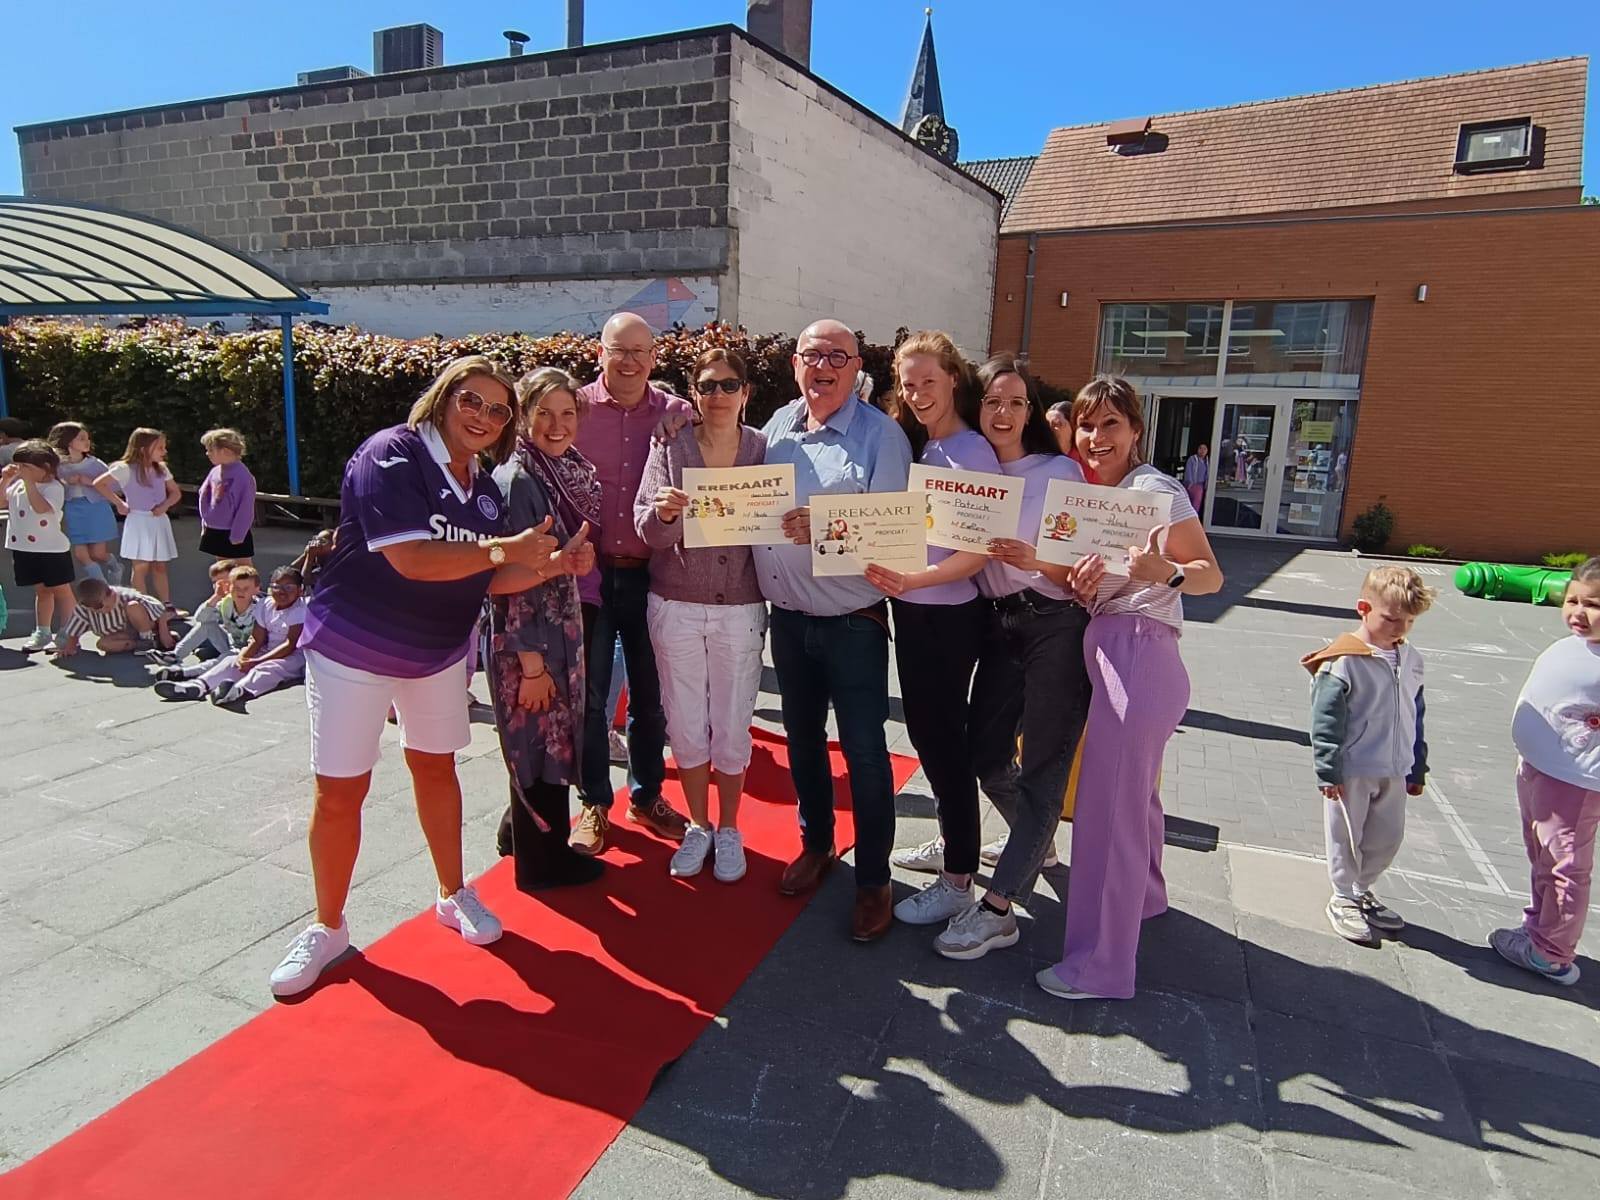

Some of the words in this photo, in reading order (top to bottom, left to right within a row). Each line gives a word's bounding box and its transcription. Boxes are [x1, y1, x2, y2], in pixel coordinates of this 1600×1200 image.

[697, 476, 783, 492] EREKAART
[925, 478, 1009, 501] EREKAART
[828, 505, 914, 518] EREKAART
[1063, 495, 1159, 517] EREKAART
